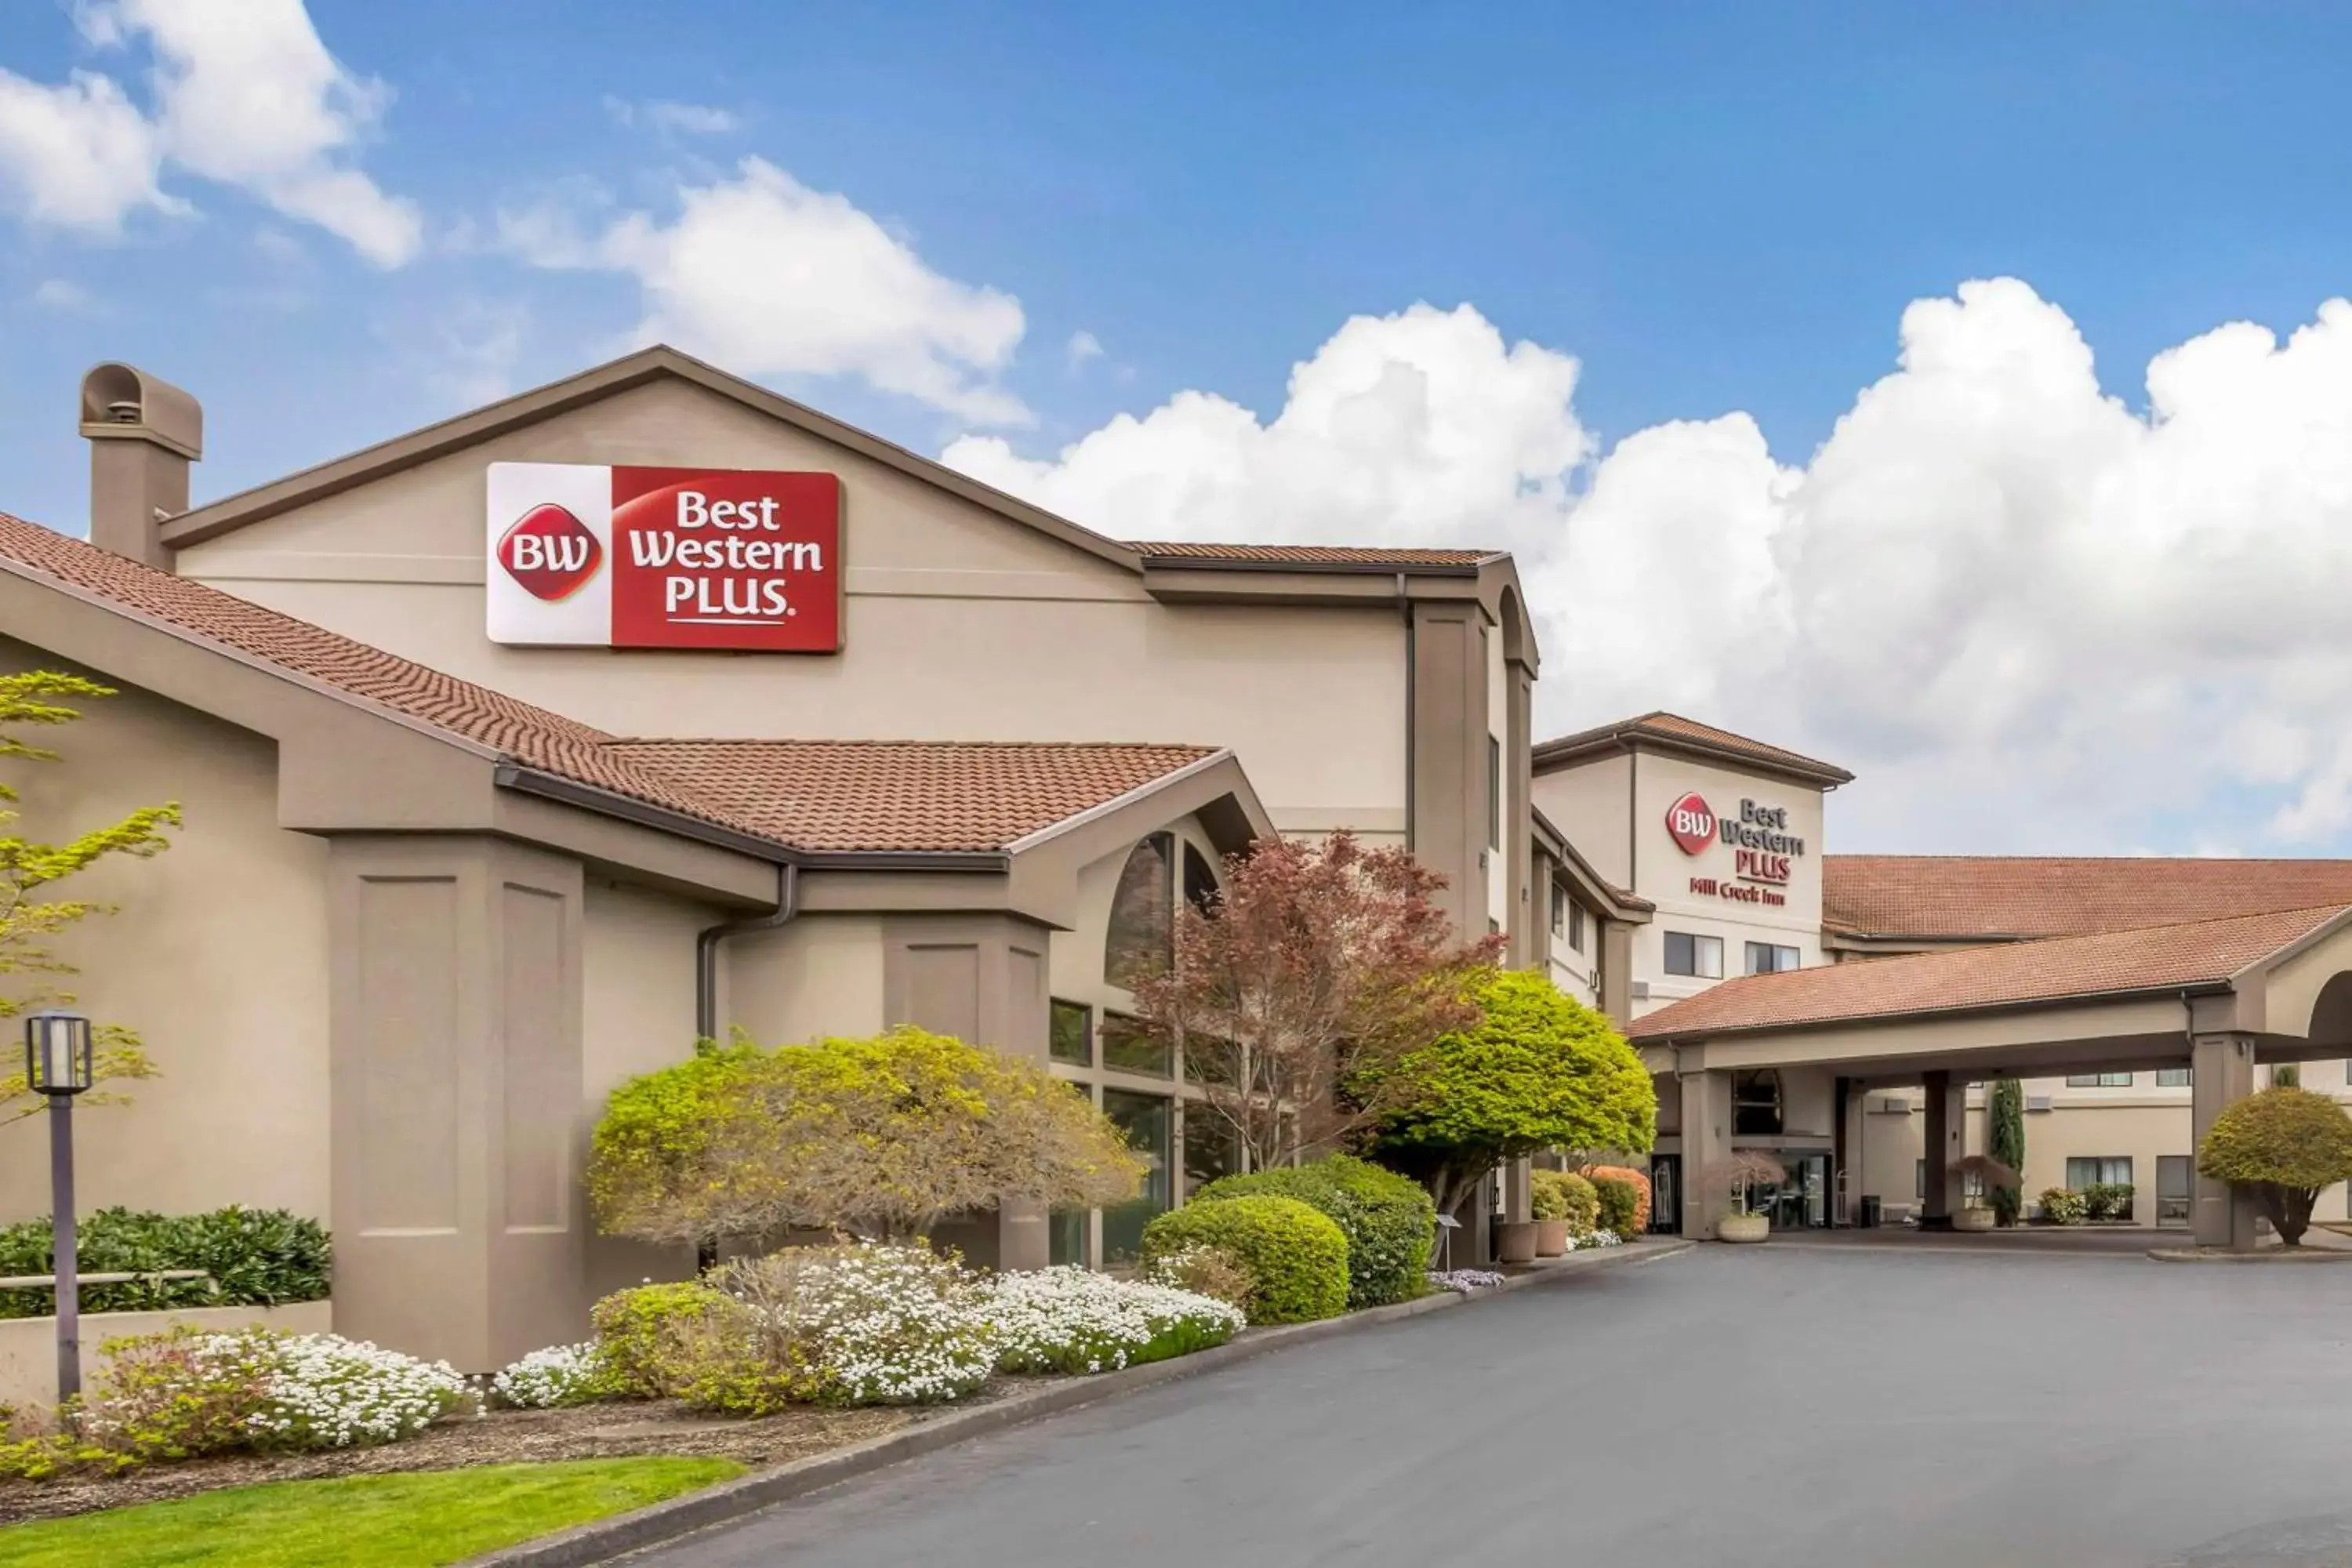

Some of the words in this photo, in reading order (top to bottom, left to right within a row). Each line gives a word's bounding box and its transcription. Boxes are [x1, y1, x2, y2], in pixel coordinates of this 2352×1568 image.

[677, 492, 781, 531] Best
[513, 535, 590, 572] BW
[630, 530, 824, 571] Western
[1676, 810, 1711, 837] BW
[1740, 798, 1788, 829] Best
[1719, 818, 1805, 856] Western
[1736, 850, 1791, 880] PLUS
[1690, 877, 1716, 895] Mill
[1720, 883, 1760, 903] Creek
[1762, 889, 1785, 906] Inn
